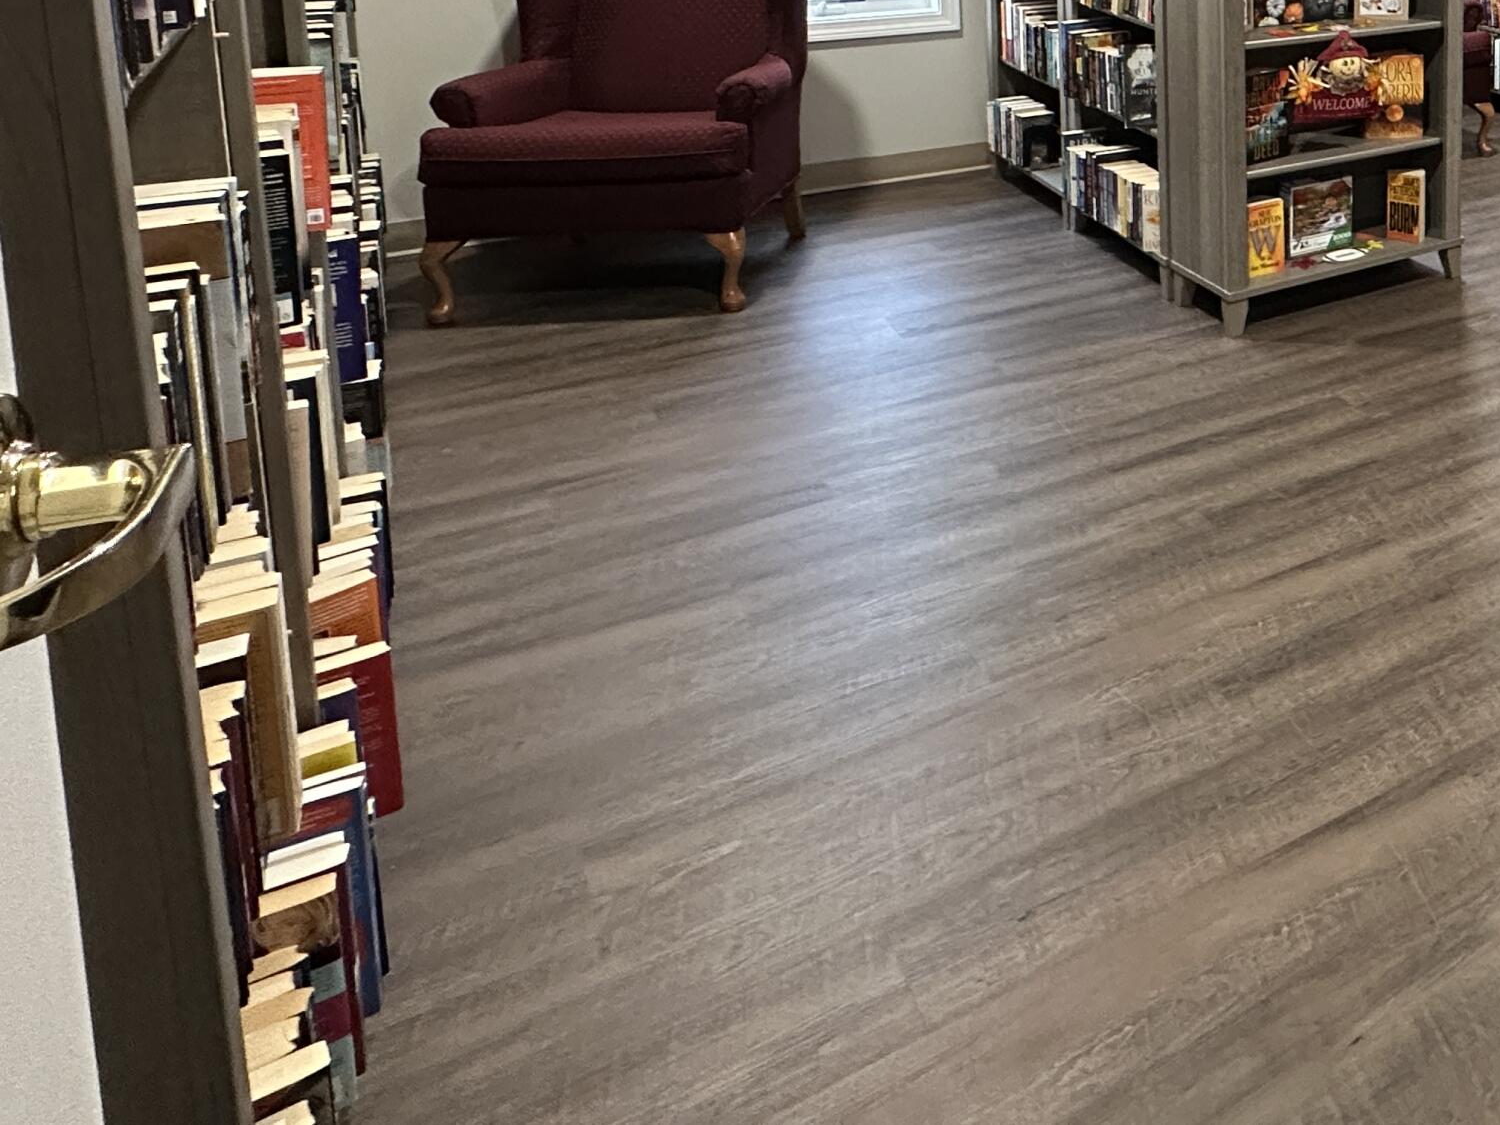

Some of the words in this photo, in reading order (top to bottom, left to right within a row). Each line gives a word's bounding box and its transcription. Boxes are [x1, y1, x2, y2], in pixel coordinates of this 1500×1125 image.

[1313, 97, 1371, 111] WELCOME
[1389, 201, 1421, 235] BURN
[1249, 226, 1280, 257] W
